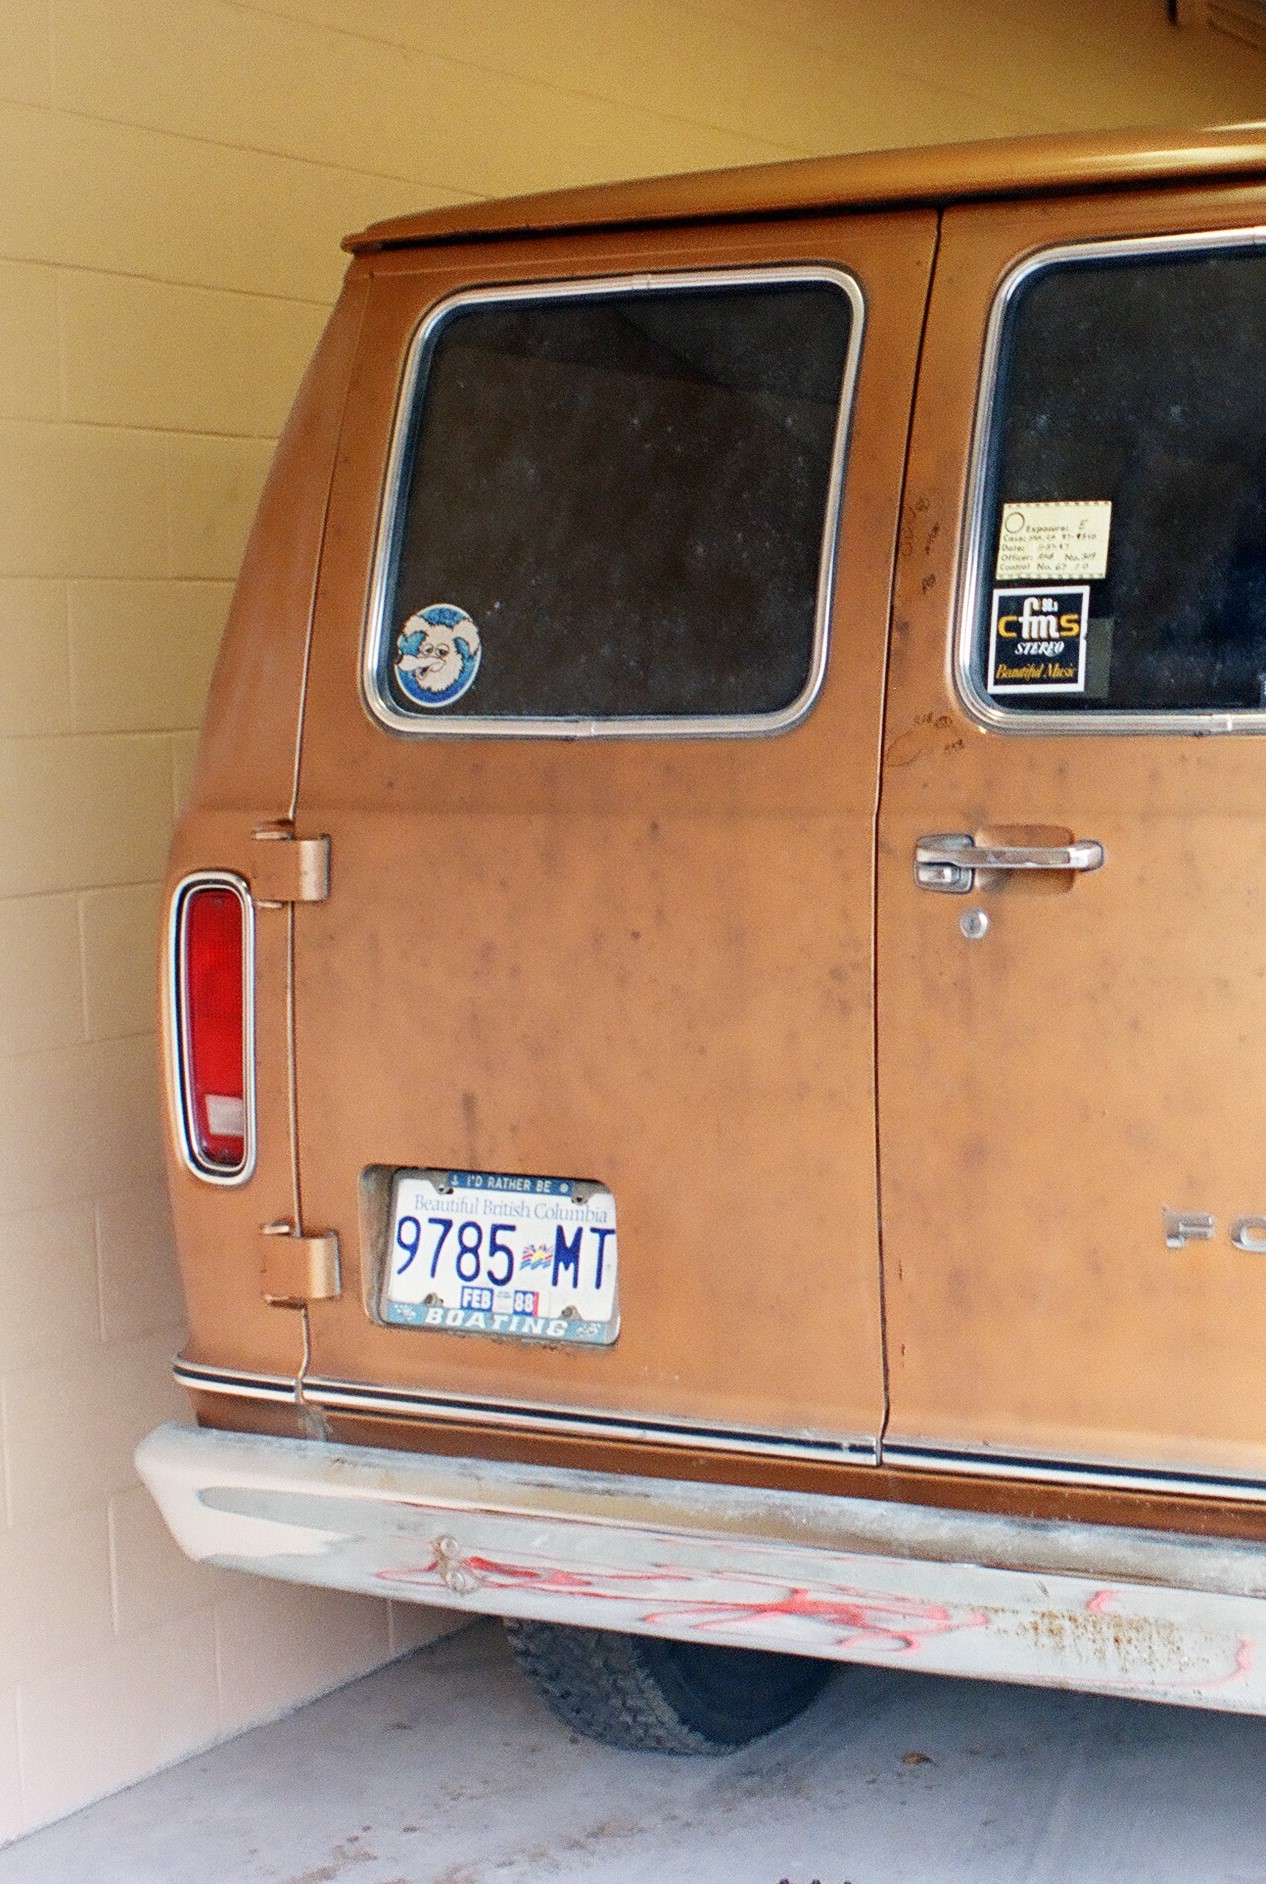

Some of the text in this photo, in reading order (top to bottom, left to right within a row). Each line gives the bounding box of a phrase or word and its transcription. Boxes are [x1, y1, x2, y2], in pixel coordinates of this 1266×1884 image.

[1014, 641, 1065, 657] STEREO
[996, 662, 1076, 681] Beautiful Music
[487, 1176, 532, 1191] RATHER
[535, 1180, 551, 1193] BE
[415, 1195, 608, 1223] Beautiful British Columbia
[396, 1215, 616, 1290] 9785 MT
[462, 1289, 493, 1309] FEB
[514, 1292, 534, 1313] 88
[424, 1307, 569, 1338] BOATING
